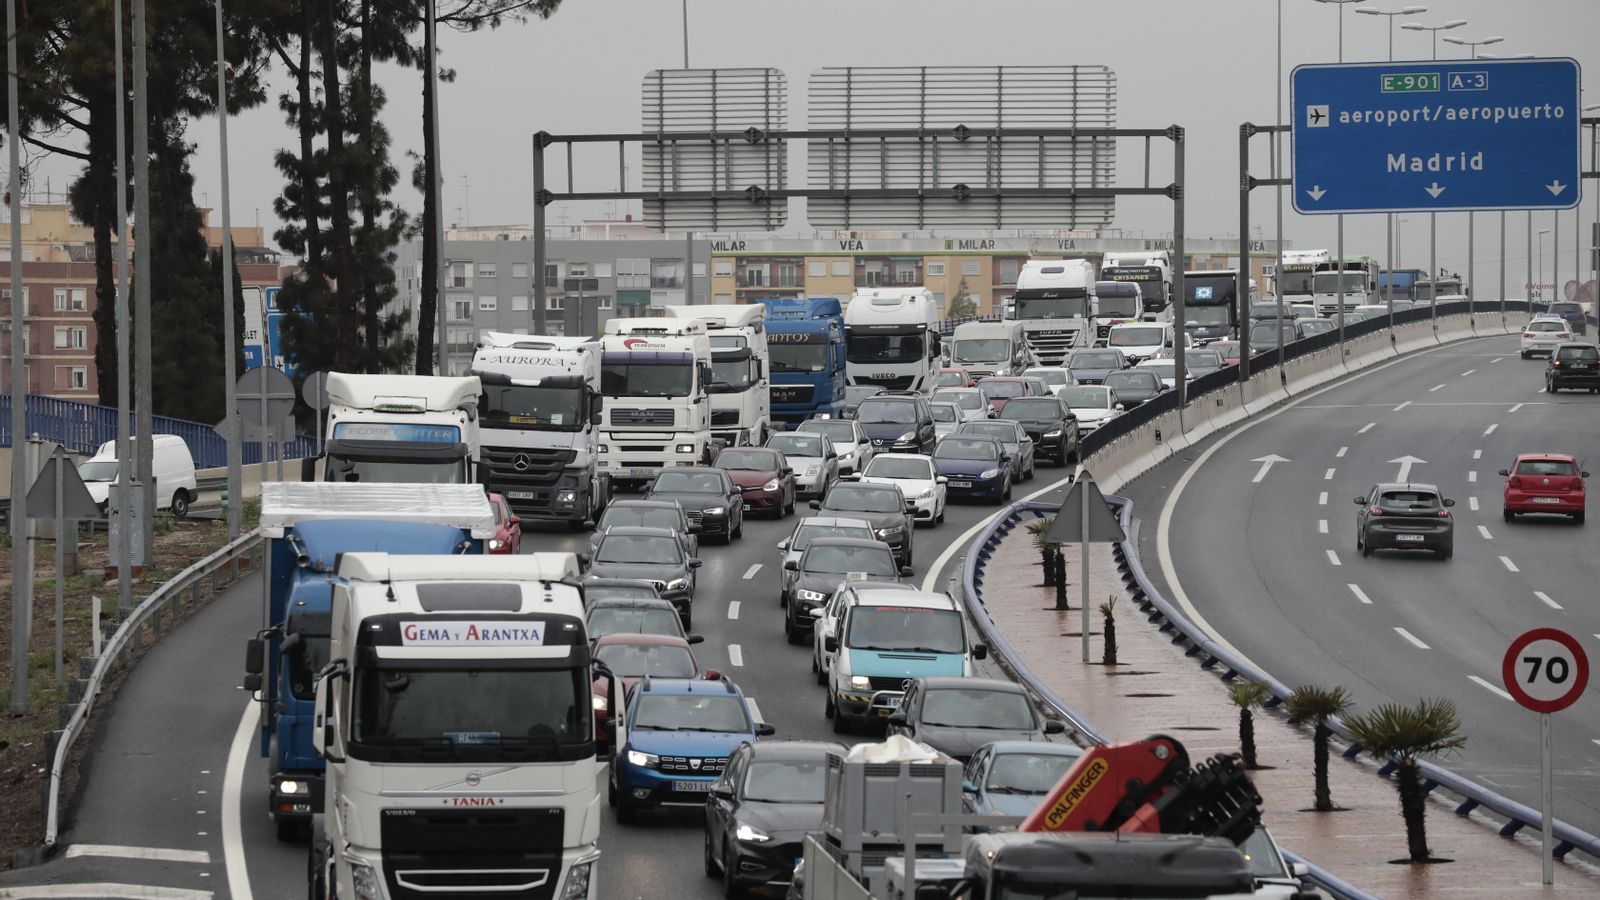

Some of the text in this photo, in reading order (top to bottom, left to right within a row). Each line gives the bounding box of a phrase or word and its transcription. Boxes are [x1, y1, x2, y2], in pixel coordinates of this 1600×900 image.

[1383, 76, 1438, 91] E-901
[1451, 74, 1485, 89] A-3
[1339, 103, 1565, 127] aeroport/aeropuerto
[1387, 151, 1484, 173] Madrid
[711, 240, 746, 251] MILAR
[840, 240, 864, 251] VEA
[959, 239, 995, 250] MILAR
[1058, 239, 1075, 250] VEA
[1154, 240, 1175, 251] MILA
[489, 355, 565, 367] AURORA
[404, 624, 450, 641] GEMA
[466, 624, 540, 641] ARANTXA
[1523, 656, 1569, 684] 70
[677, 782, 697, 791] 5201
[1048, 762, 1105, 825] PALFINGER
[452, 797, 495, 806] TANIA
